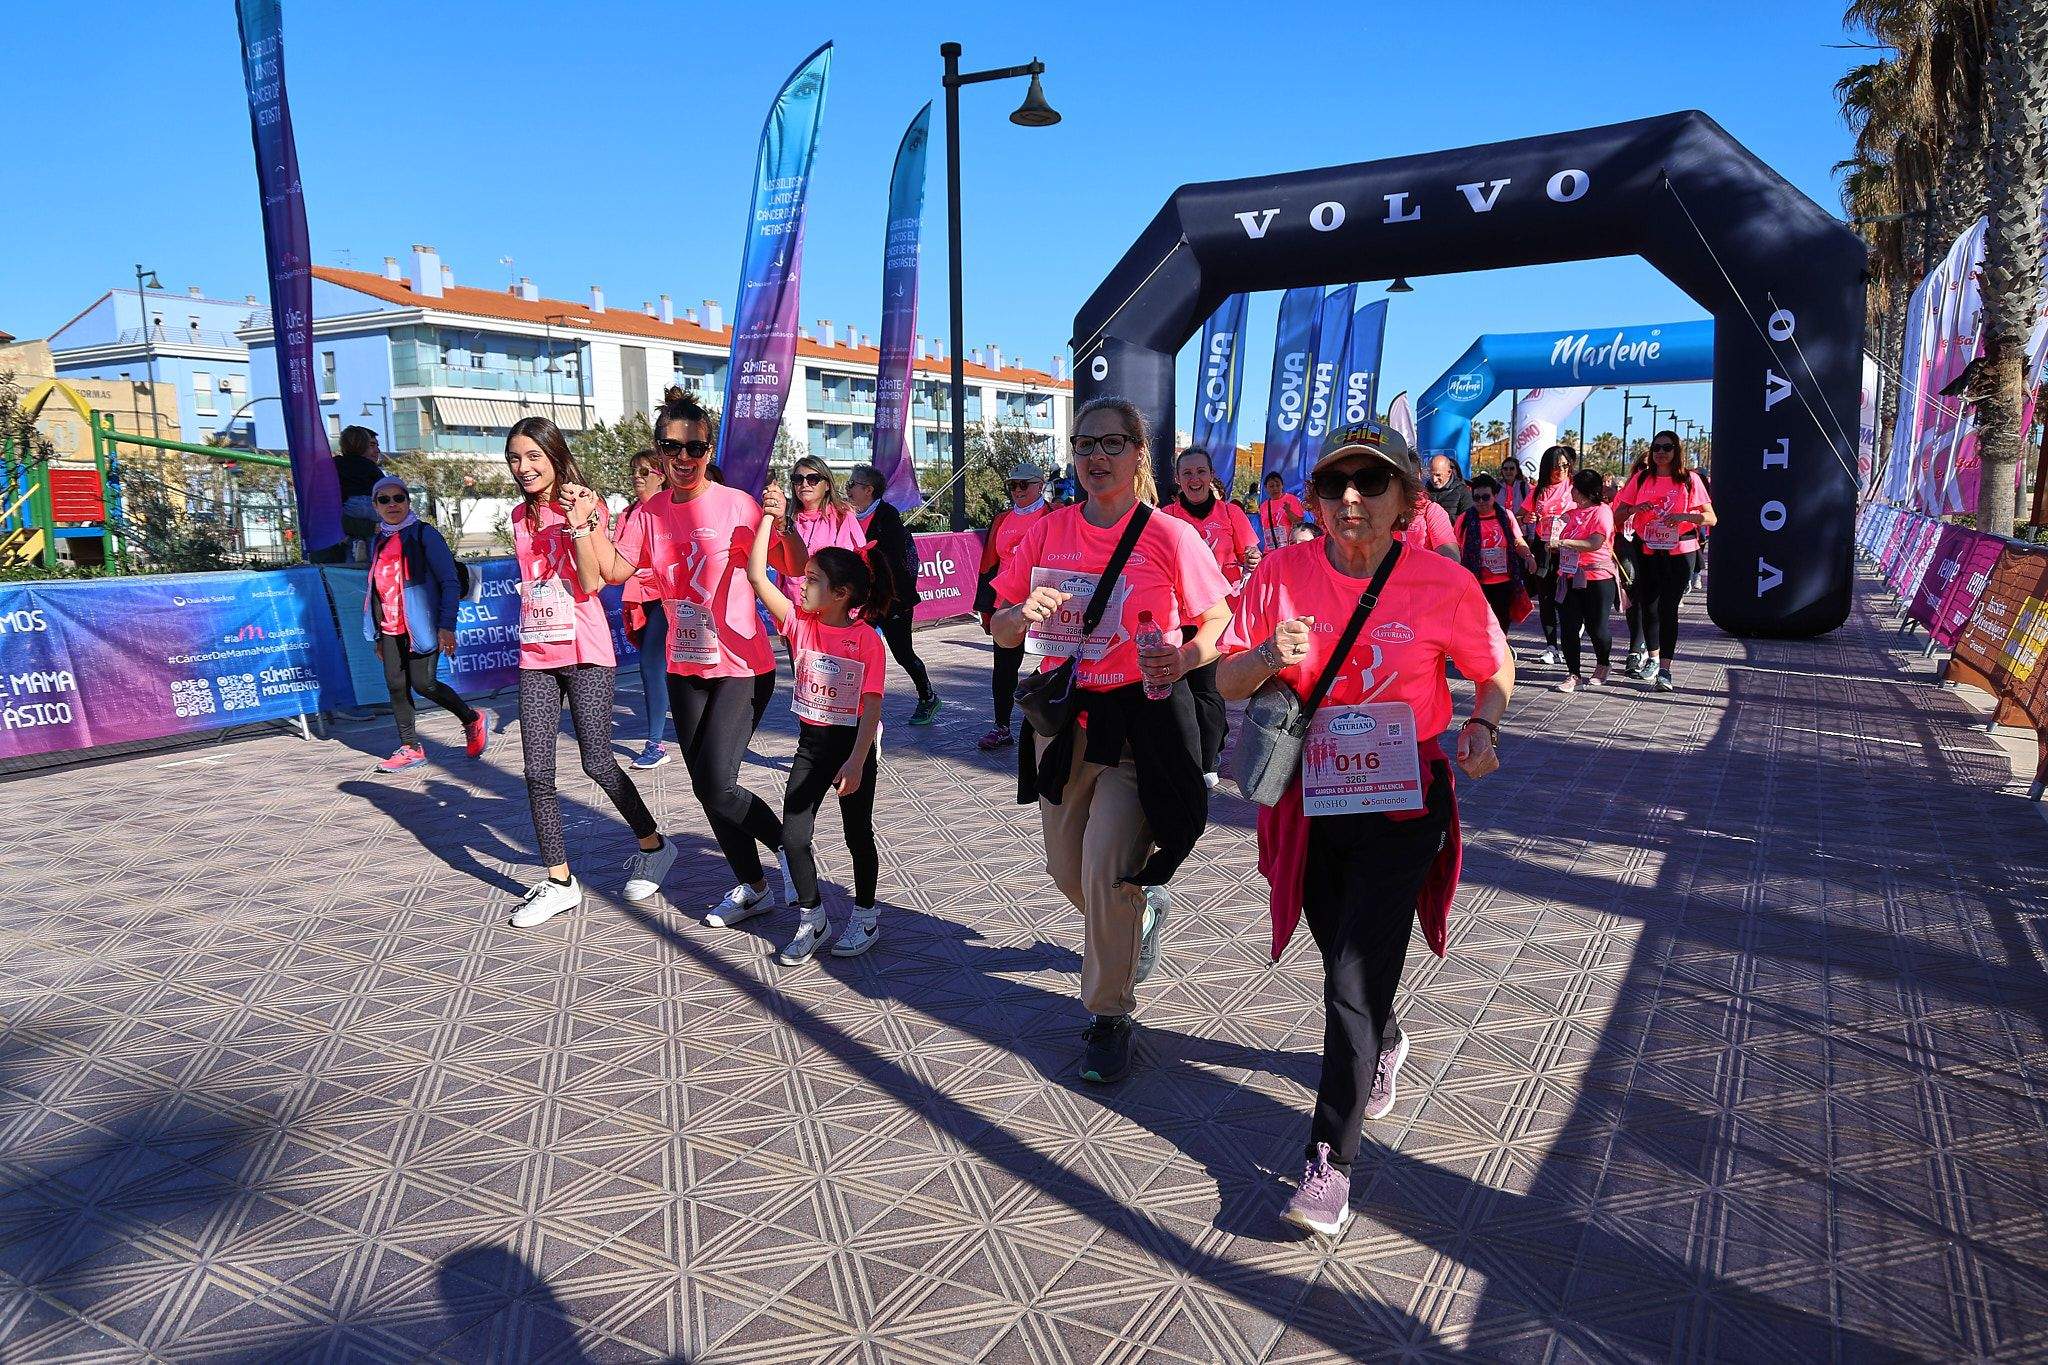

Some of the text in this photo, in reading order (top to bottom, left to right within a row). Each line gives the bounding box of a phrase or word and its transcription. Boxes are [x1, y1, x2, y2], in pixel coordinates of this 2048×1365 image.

[1234, 169, 1590, 239] VOLVO
[1204, 332, 1235, 424] GOYA
[1277, 352, 1305, 432] GOYA
[1308, 362, 1333, 437] GOYA
[1346, 372, 1368, 424] OYA
[1333, 427, 1389, 445] CHILE
[1757, 309, 1795, 597] VOLVO
[918, 550, 956, 585] enfe
[935, 587, 961, 599] OFICIAL
[475, 605, 498, 621] EL
[533, 607, 554, 619] 016
[1061, 610, 1081, 625] 01
[677, 628, 697, 639] 016
[1036, 642, 1065, 652] OYSHO
[9, 670, 77, 696] MAMA
[259, 666, 304, 684] SÚMATE
[1094, 673, 1124, 685] MUJER
[262, 680, 320, 697] MOVIMIENTO
[811, 683, 838, 698] 016
[0, 701, 73, 730] ÁSICO
[1332, 722, 1373, 731] ASTURIANA
[1335, 752, 1380, 772] 016
[1345, 775, 1367, 784] 3263
[1315, 787, 1337, 795] CARRERA
[1354, 785, 1374, 793] MUJER
[1377, 783, 1405, 791] VALENCIA
[1314, 797, 1408, 809] OYSHO Santander
